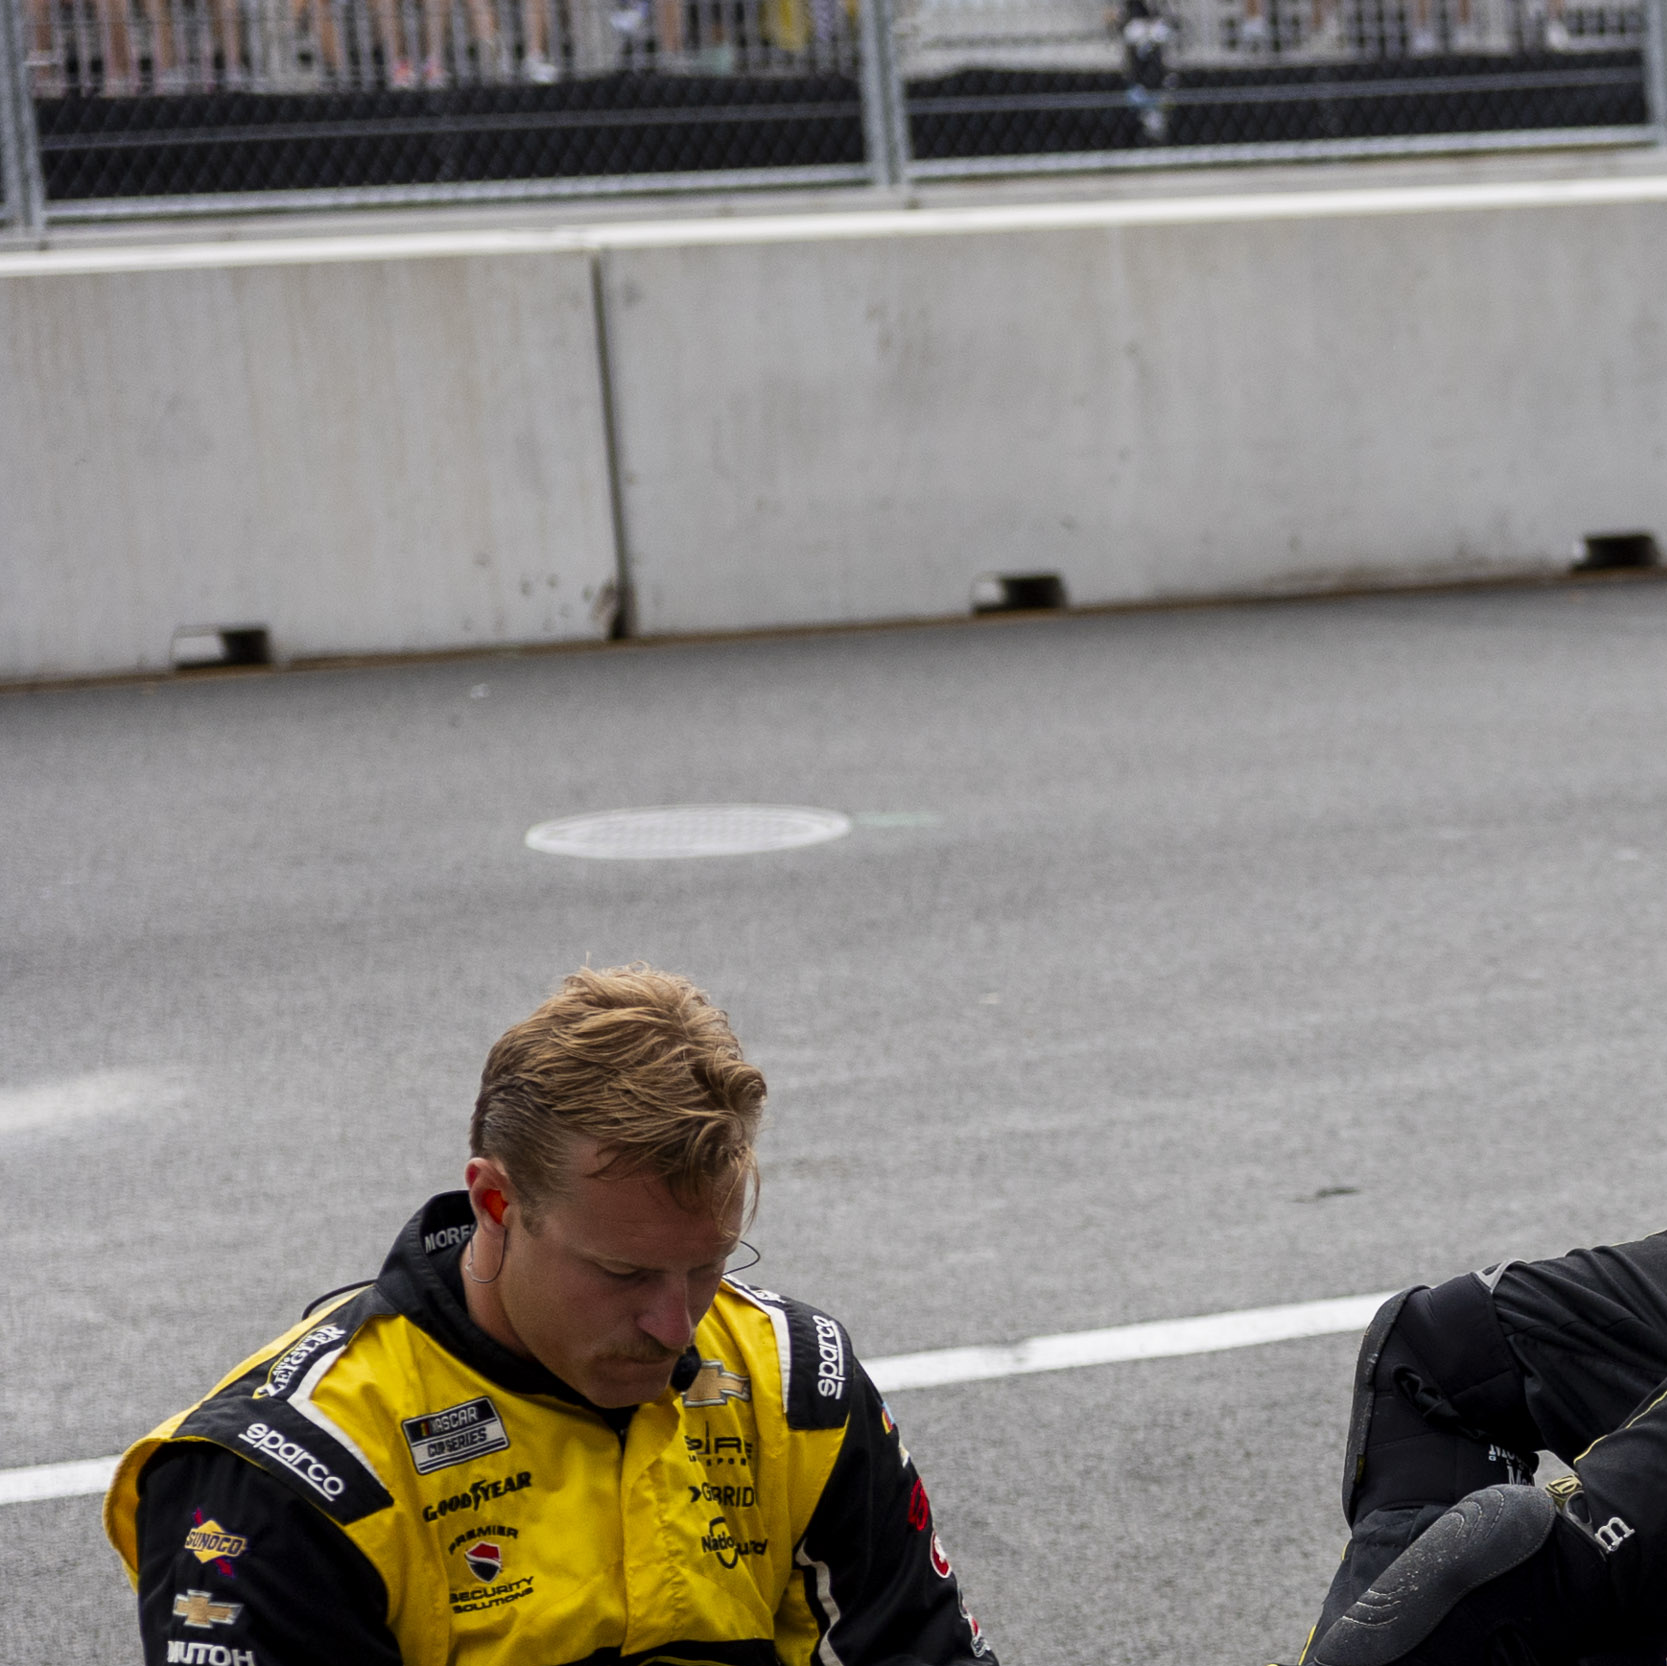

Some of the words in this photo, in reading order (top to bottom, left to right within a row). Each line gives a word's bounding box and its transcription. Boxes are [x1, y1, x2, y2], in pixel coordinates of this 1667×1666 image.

[812, 1314, 844, 1399] sparco
[239, 1423, 345, 1501] sparco
[422, 1472, 532, 1522] GOODYEAR
[186, 1530, 246, 1556] SUNOCO
[448, 1525, 519, 1555] PREMIER
[450, 1576, 534, 1604] SECURITY
[452, 1587, 534, 1614] SOLUTIONS
